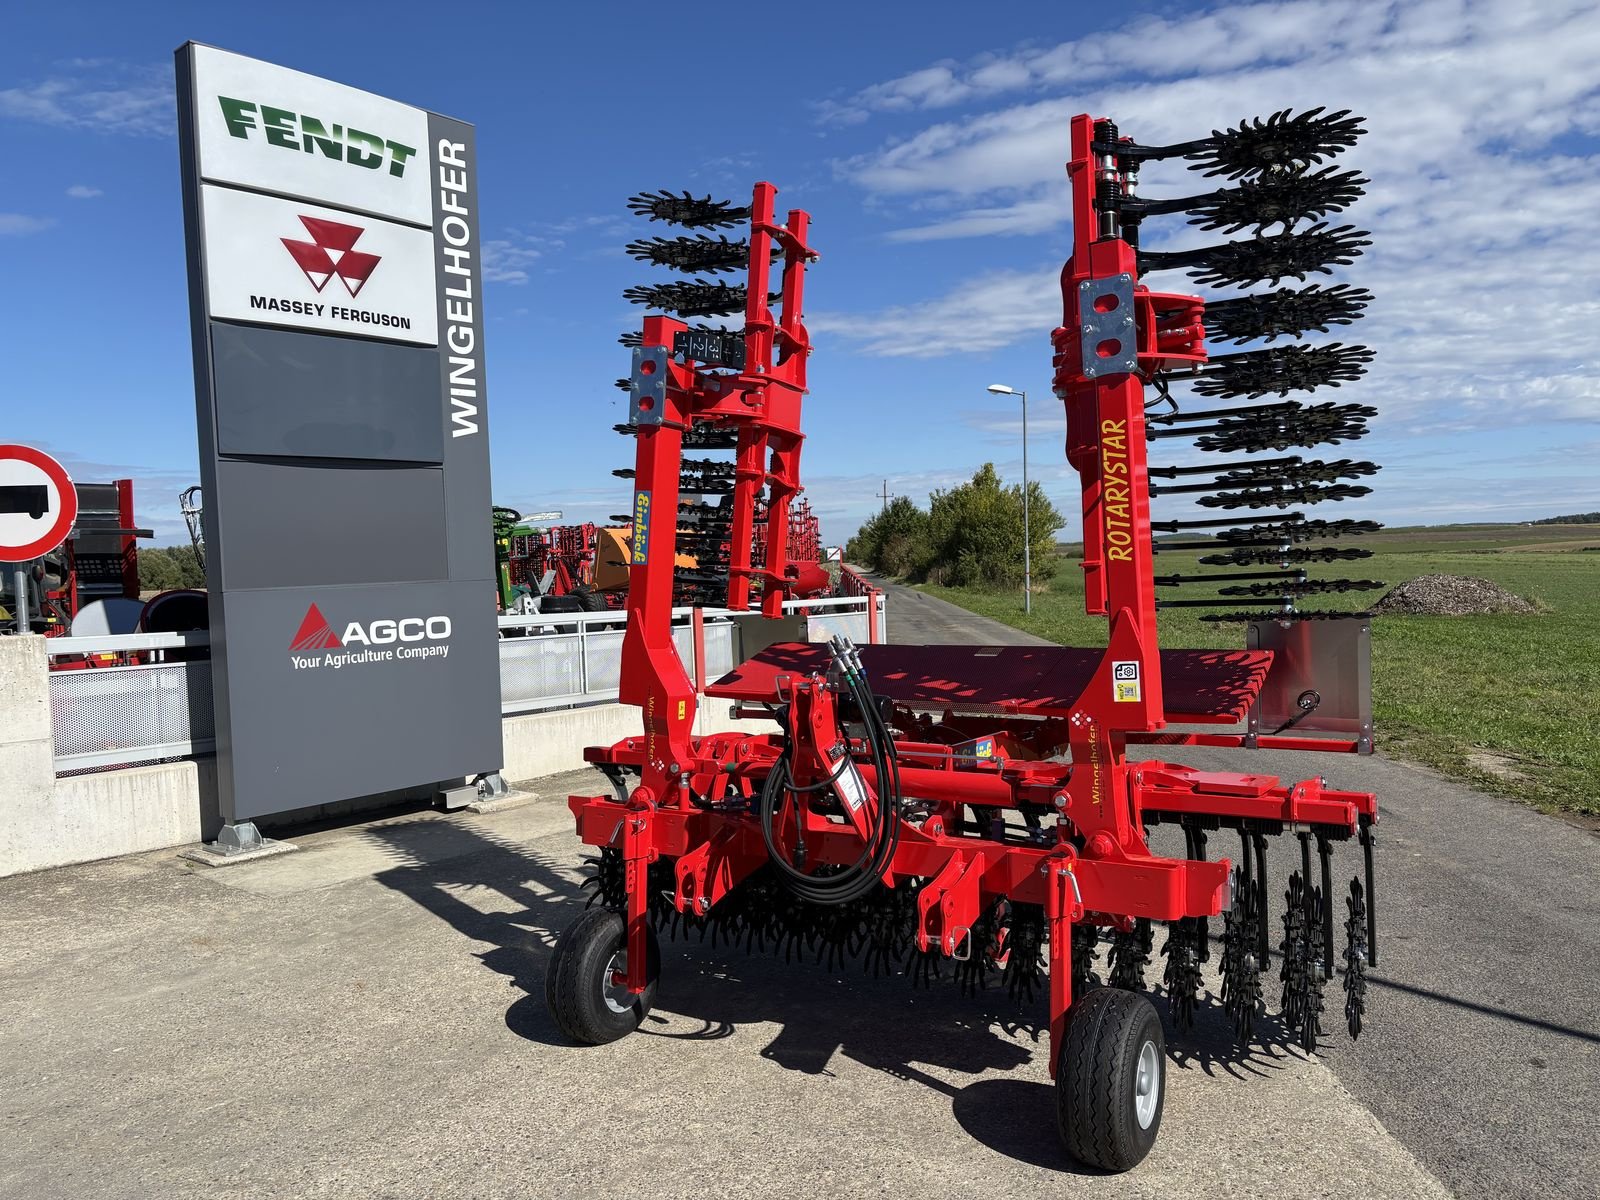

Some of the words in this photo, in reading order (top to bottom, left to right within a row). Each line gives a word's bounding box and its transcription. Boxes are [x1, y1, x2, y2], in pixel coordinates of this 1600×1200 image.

[217, 95, 417, 179] FENDT
[249, 295, 325, 317] MASSEY
[331, 306, 411, 330] FERGUSON
[439, 138, 478, 438] WINGELHOFER
[1101, 419, 1133, 561] ROTARYSTAR
[634, 493, 649, 563] Einböck
[291, 655, 321, 670] Your
[324, 649, 393, 669] Agriculture
[396, 645, 449, 660] Company
[341, 615, 452, 647] AGCO
